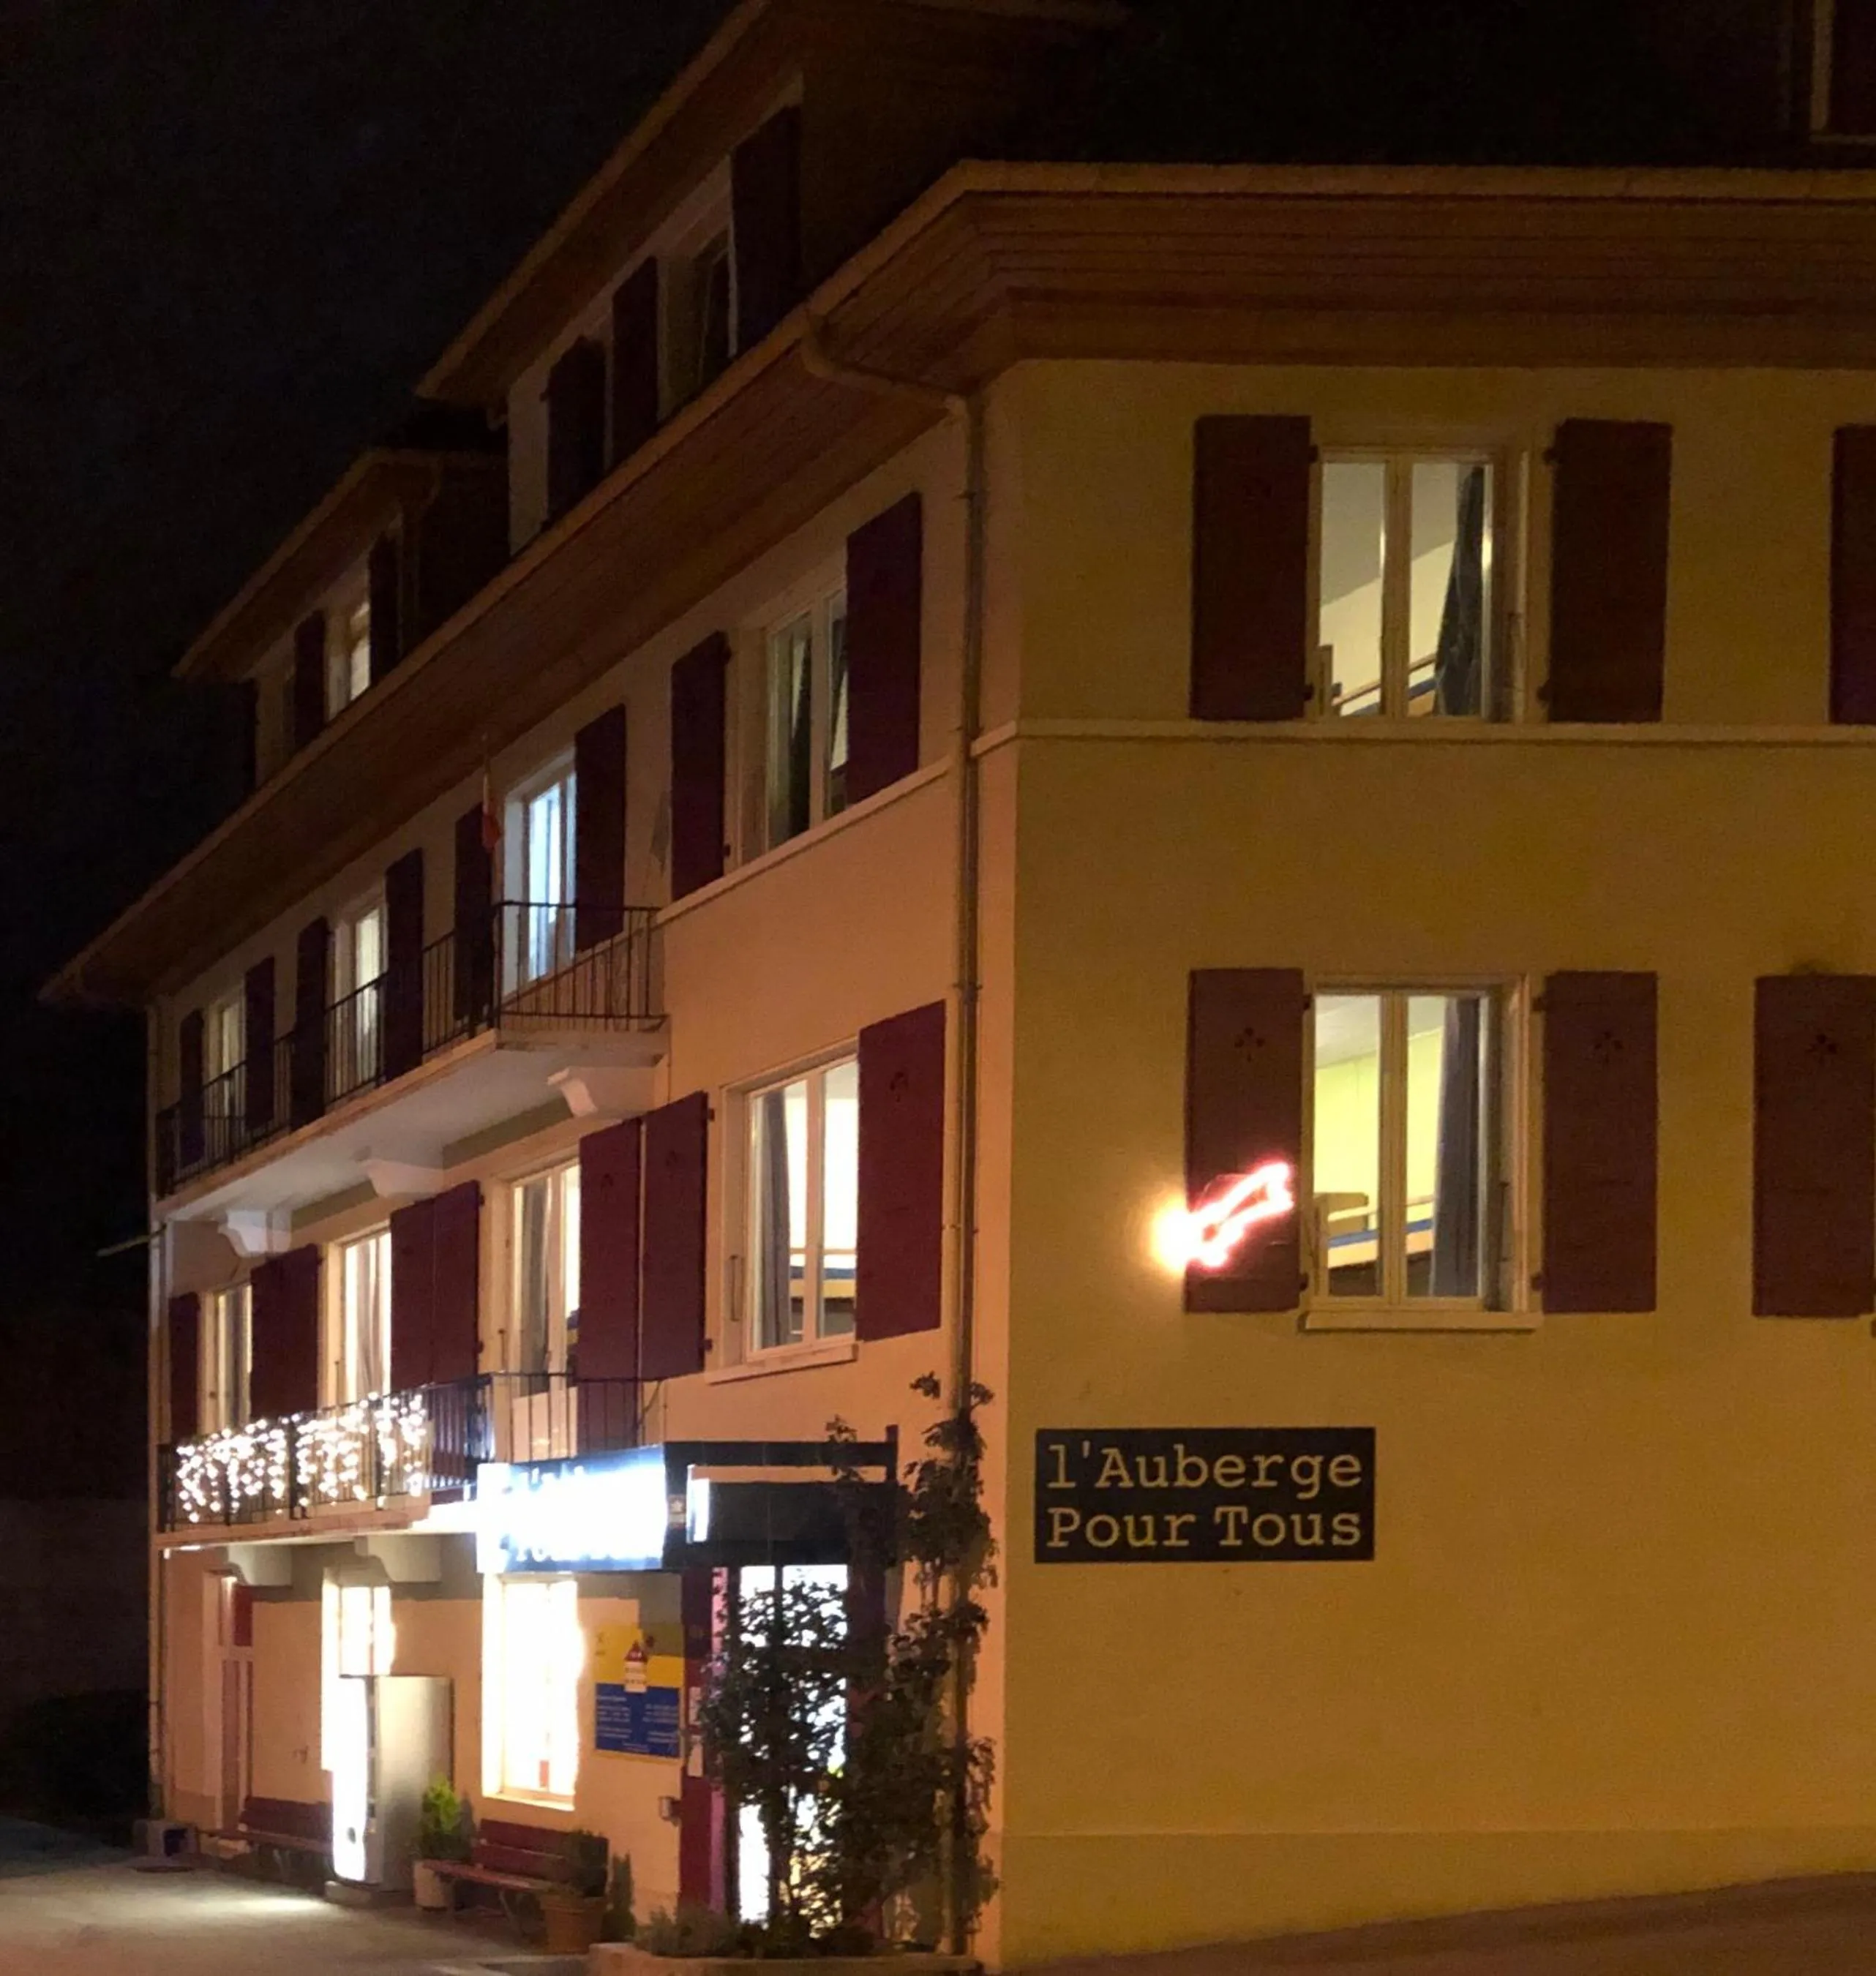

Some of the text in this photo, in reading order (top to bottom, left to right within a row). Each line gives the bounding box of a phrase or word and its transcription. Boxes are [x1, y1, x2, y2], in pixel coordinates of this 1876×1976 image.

[1047, 1440, 1362, 1500] l'Auberge
[1046, 1505, 1362, 1548] Pour Tous
